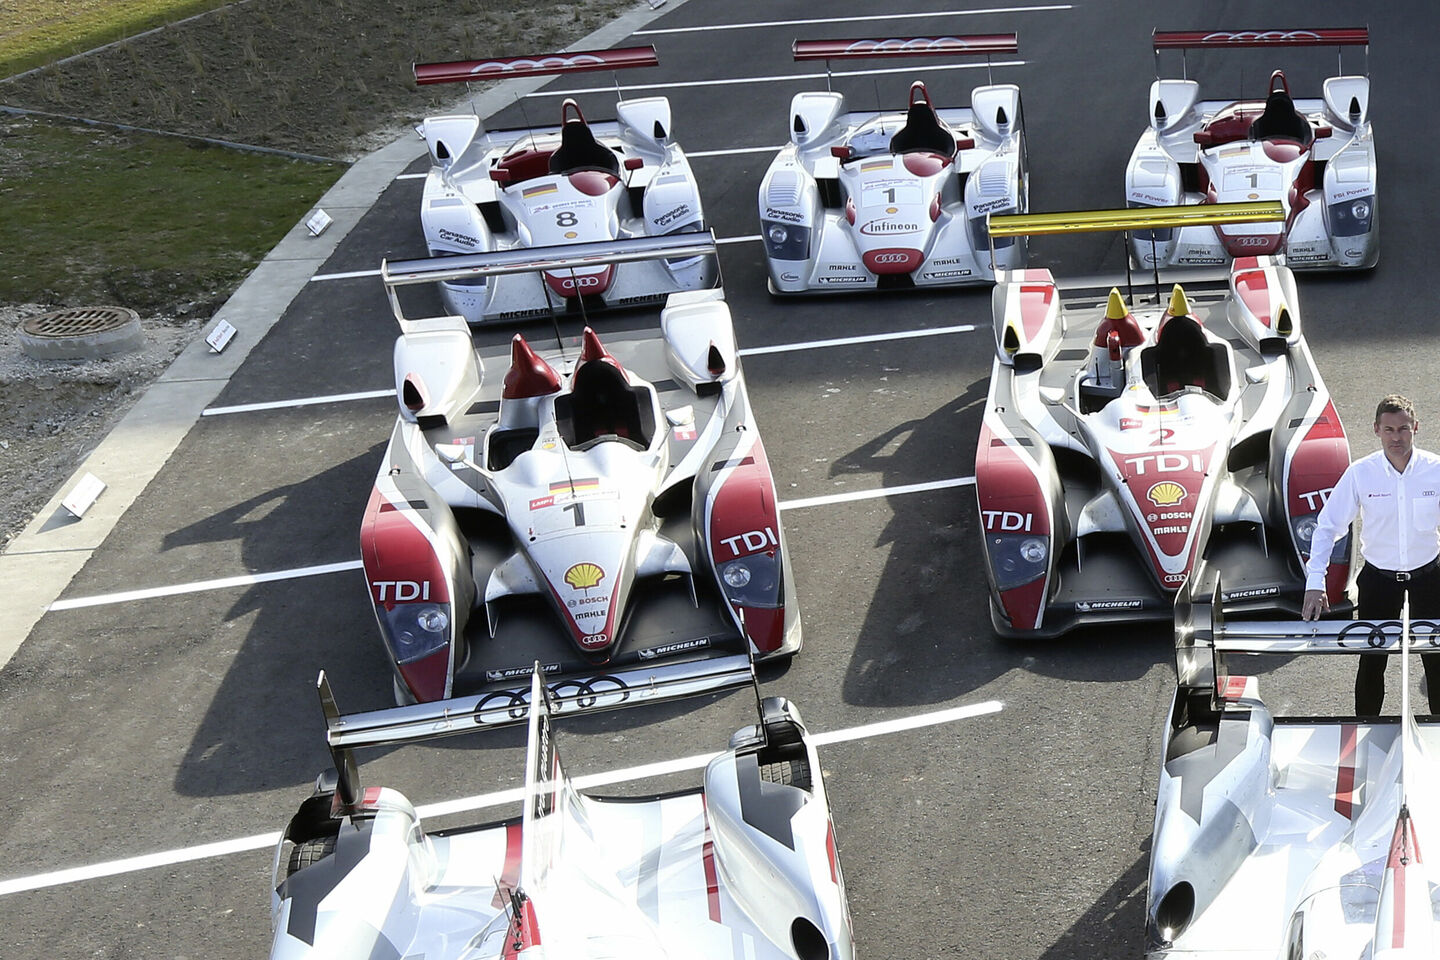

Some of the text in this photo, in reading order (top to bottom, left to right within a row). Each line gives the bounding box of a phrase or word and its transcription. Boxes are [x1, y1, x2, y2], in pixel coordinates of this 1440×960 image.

[1245, 173, 1258, 189] 1
[881, 188, 897, 204] 1
[1144, 194, 1170, 204] Power
[1345, 187, 1370, 197] Power
[973, 197, 1011, 212] Panasonic
[978, 201, 1011, 214] Car Audio
[556, 211, 579, 227] 8
[653, 204, 689, 225] Panasonic
[660, 208, 690, 227] Car Audio
[766, 207, 805, 220] Panasonic
[767, 212, 801, 223] Car Audio
[438, 228, 481, 245] Panasonic
[439, 232, 476, 248] Car Audio
[933, 258, 960, 266] MAHLE
[934, 270, 971, 278] MICHELIN
[1149, 428, 1177, 447] 2
[1124, 453, 1205, 476] TDI
[562, 502, 586, 527] 1
[982, 510, 1034, 532] TDI
[1160, 511, 1193, 521] BOSCH
[1153, 525, 1188, 535] MAHLE
[720, 526, 778, 556] TDI
[373, 581, 430, 601] TDI
[1230, 587, 1277, 599] MICHELIN
[578, 595, 609, 606] BOSCH
[1091, 600, 1141, 609] MICHELIN
[575, 609, 607, 621] MAHLE
[656, 637, 707, 655] MICHELIN
